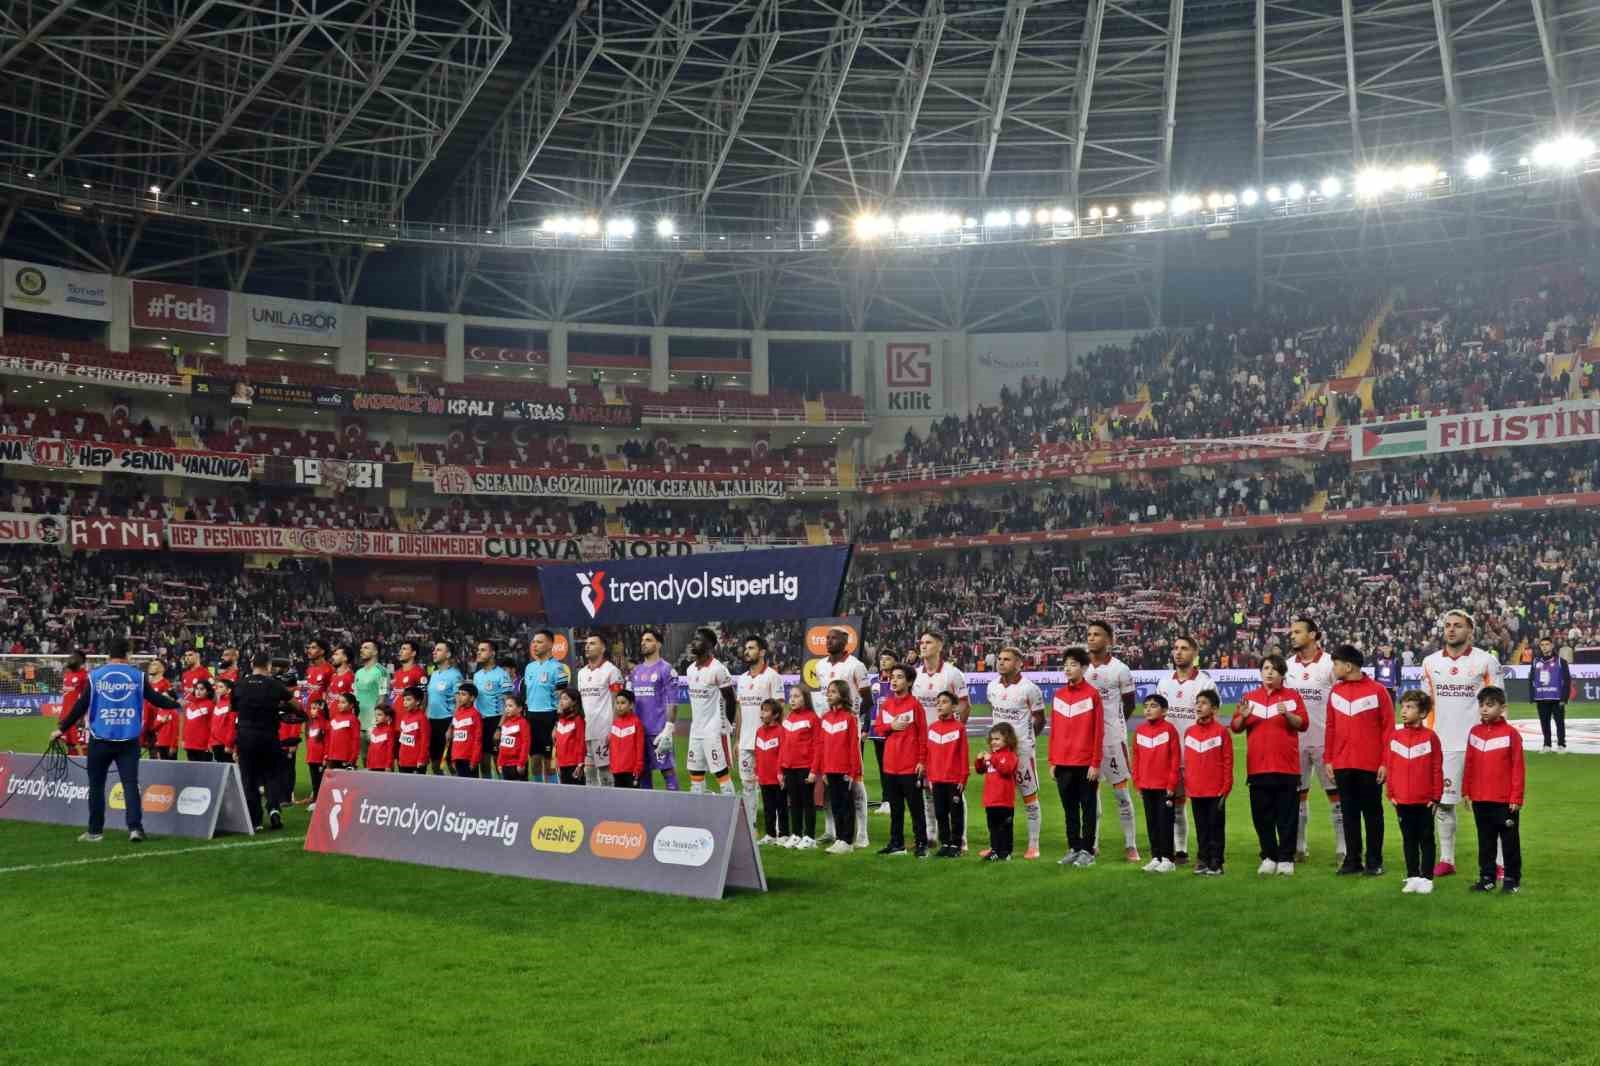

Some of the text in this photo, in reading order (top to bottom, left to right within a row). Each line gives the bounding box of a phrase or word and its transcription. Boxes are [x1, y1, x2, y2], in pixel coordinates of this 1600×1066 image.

[147, 294, 216, 324] #Feda
[252, 308, 337, 329] UNILABOR
[887, 391, 931, 411] Kilit
[79, 446, 112, 467] HEP
[120, 451, 174, 472] SENİN
[181, 455, 249, 477] YANINDA
[626, 478, 657, 496] YOK
[171, 527, 197, 545] HEP
[484, 537, 693, 560] CURVA NORD
[608, 571, 709, 605] trendyol
[100, 708, 136, 719] 2570
[711, 749, 719, 761] 6
[1109, 757, 1118, 769] 4
[359, 799, 446, 836] trendyol
[537, 824, 577, 843] NESİNE
[595, 832, 642, 849] trendyol
